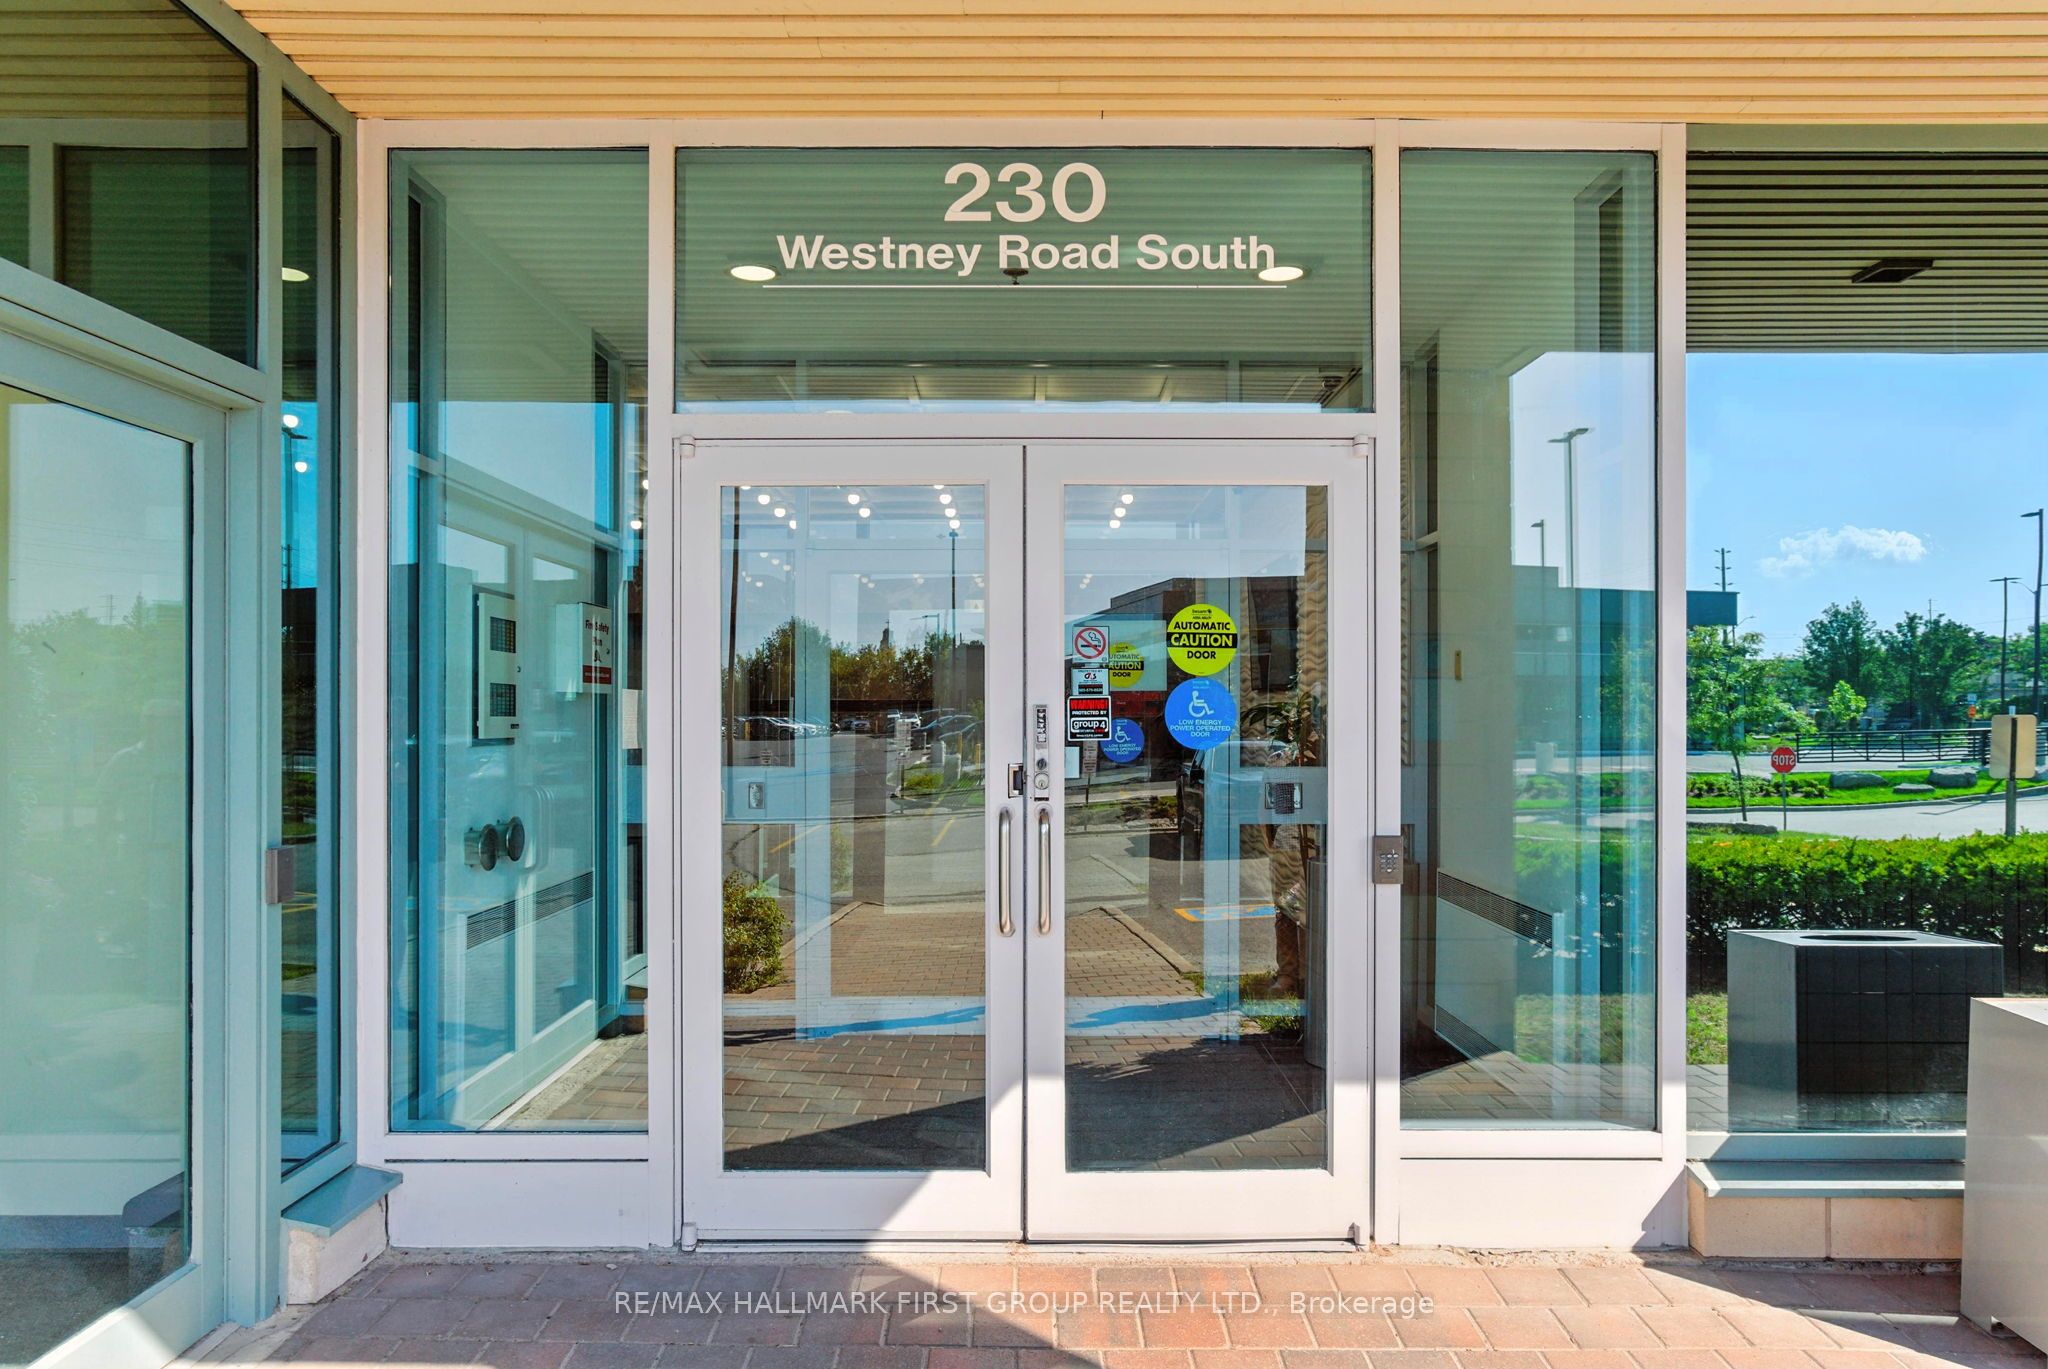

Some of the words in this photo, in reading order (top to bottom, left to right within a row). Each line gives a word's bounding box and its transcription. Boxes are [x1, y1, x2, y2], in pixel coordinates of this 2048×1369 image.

[944, 162, 1106, 223] 230
[777, 234, 982, 277] Westney
[1001, 234, 1120, 270] Road
[1136, 234, 1275, 271] South
[1174, 621, 1231, 630] AUTOMATIC
[1171, 633, 1233, 647] CAUTION
[1187, 650, 1216, 659] DOOR
[1073, 721, 1099, 730] group
[1100, 721, 1106, 729] 4
